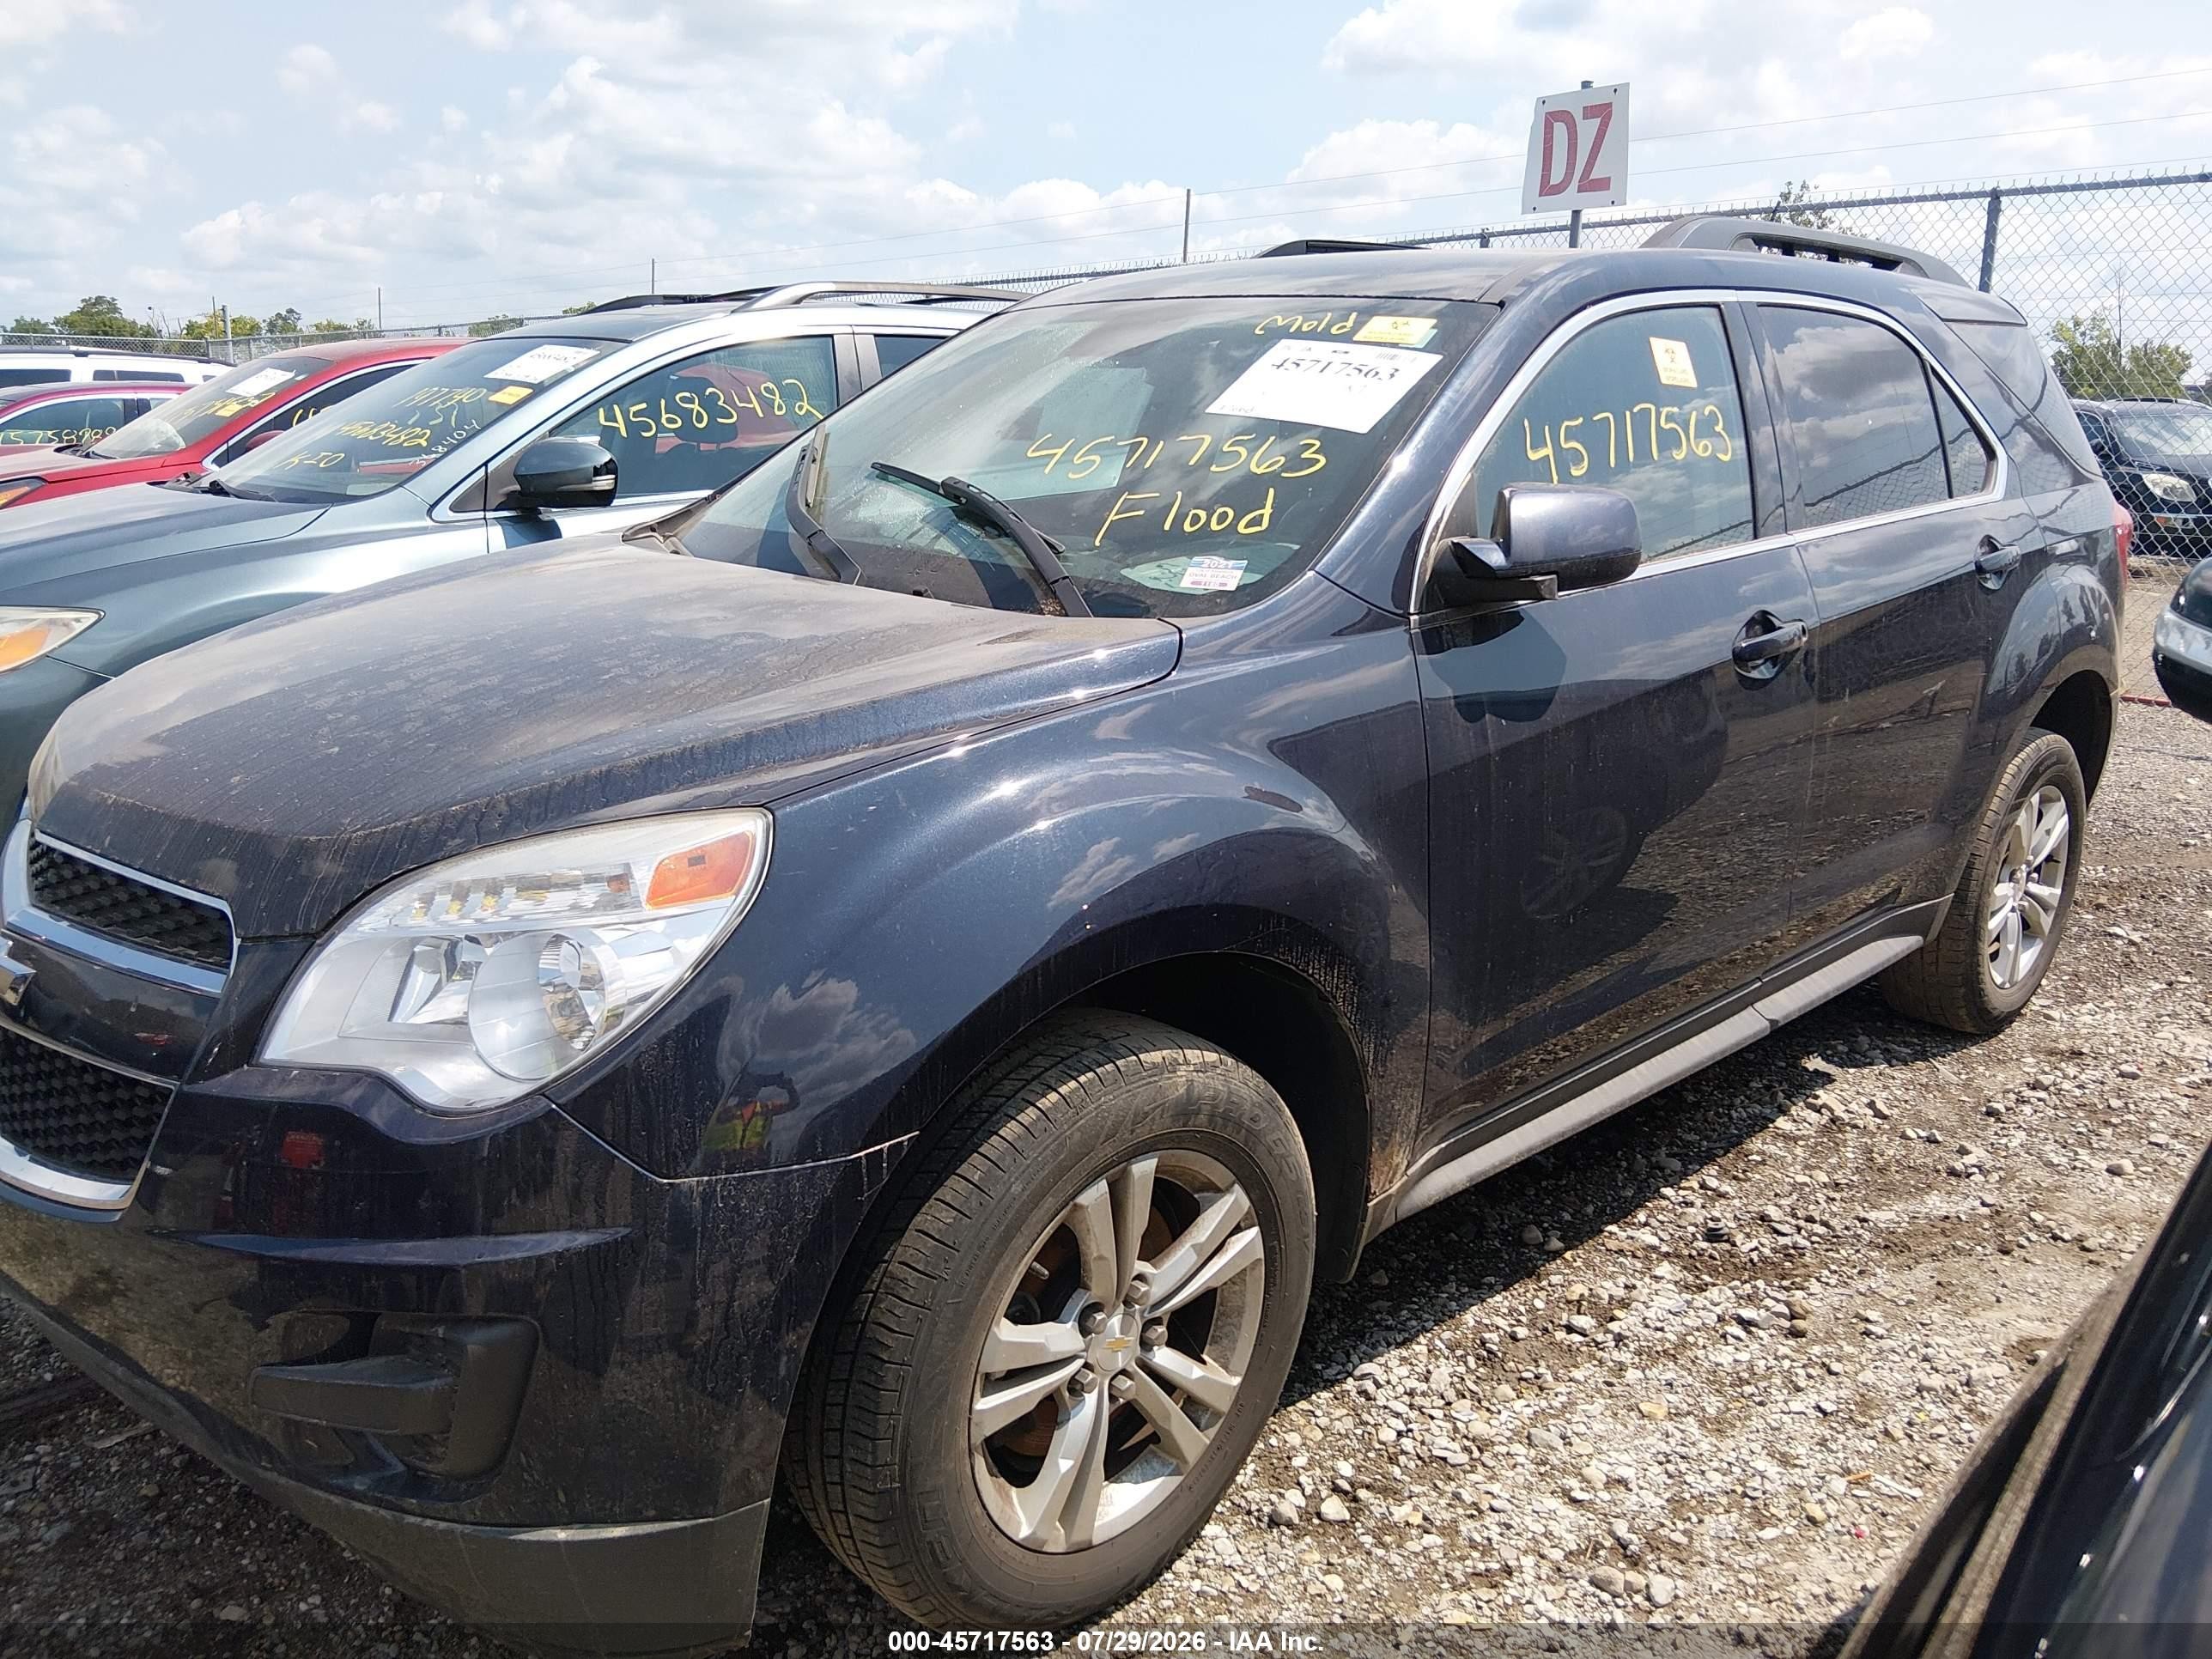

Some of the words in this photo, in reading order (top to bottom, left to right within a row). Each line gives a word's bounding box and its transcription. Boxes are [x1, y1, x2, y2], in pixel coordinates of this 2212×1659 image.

[1539, 101, 1613, 198] DZ
[1255, 312, 1358, 335] Mold
[1271, 357, 1400, 380] 45717563
[598, 379, 825, 438] 45683482
[1025, 433, 1328, 481] 45717563
[1524, 404, 1733, 485] 45717563
[1094, 487, 1276, 548] Flood
